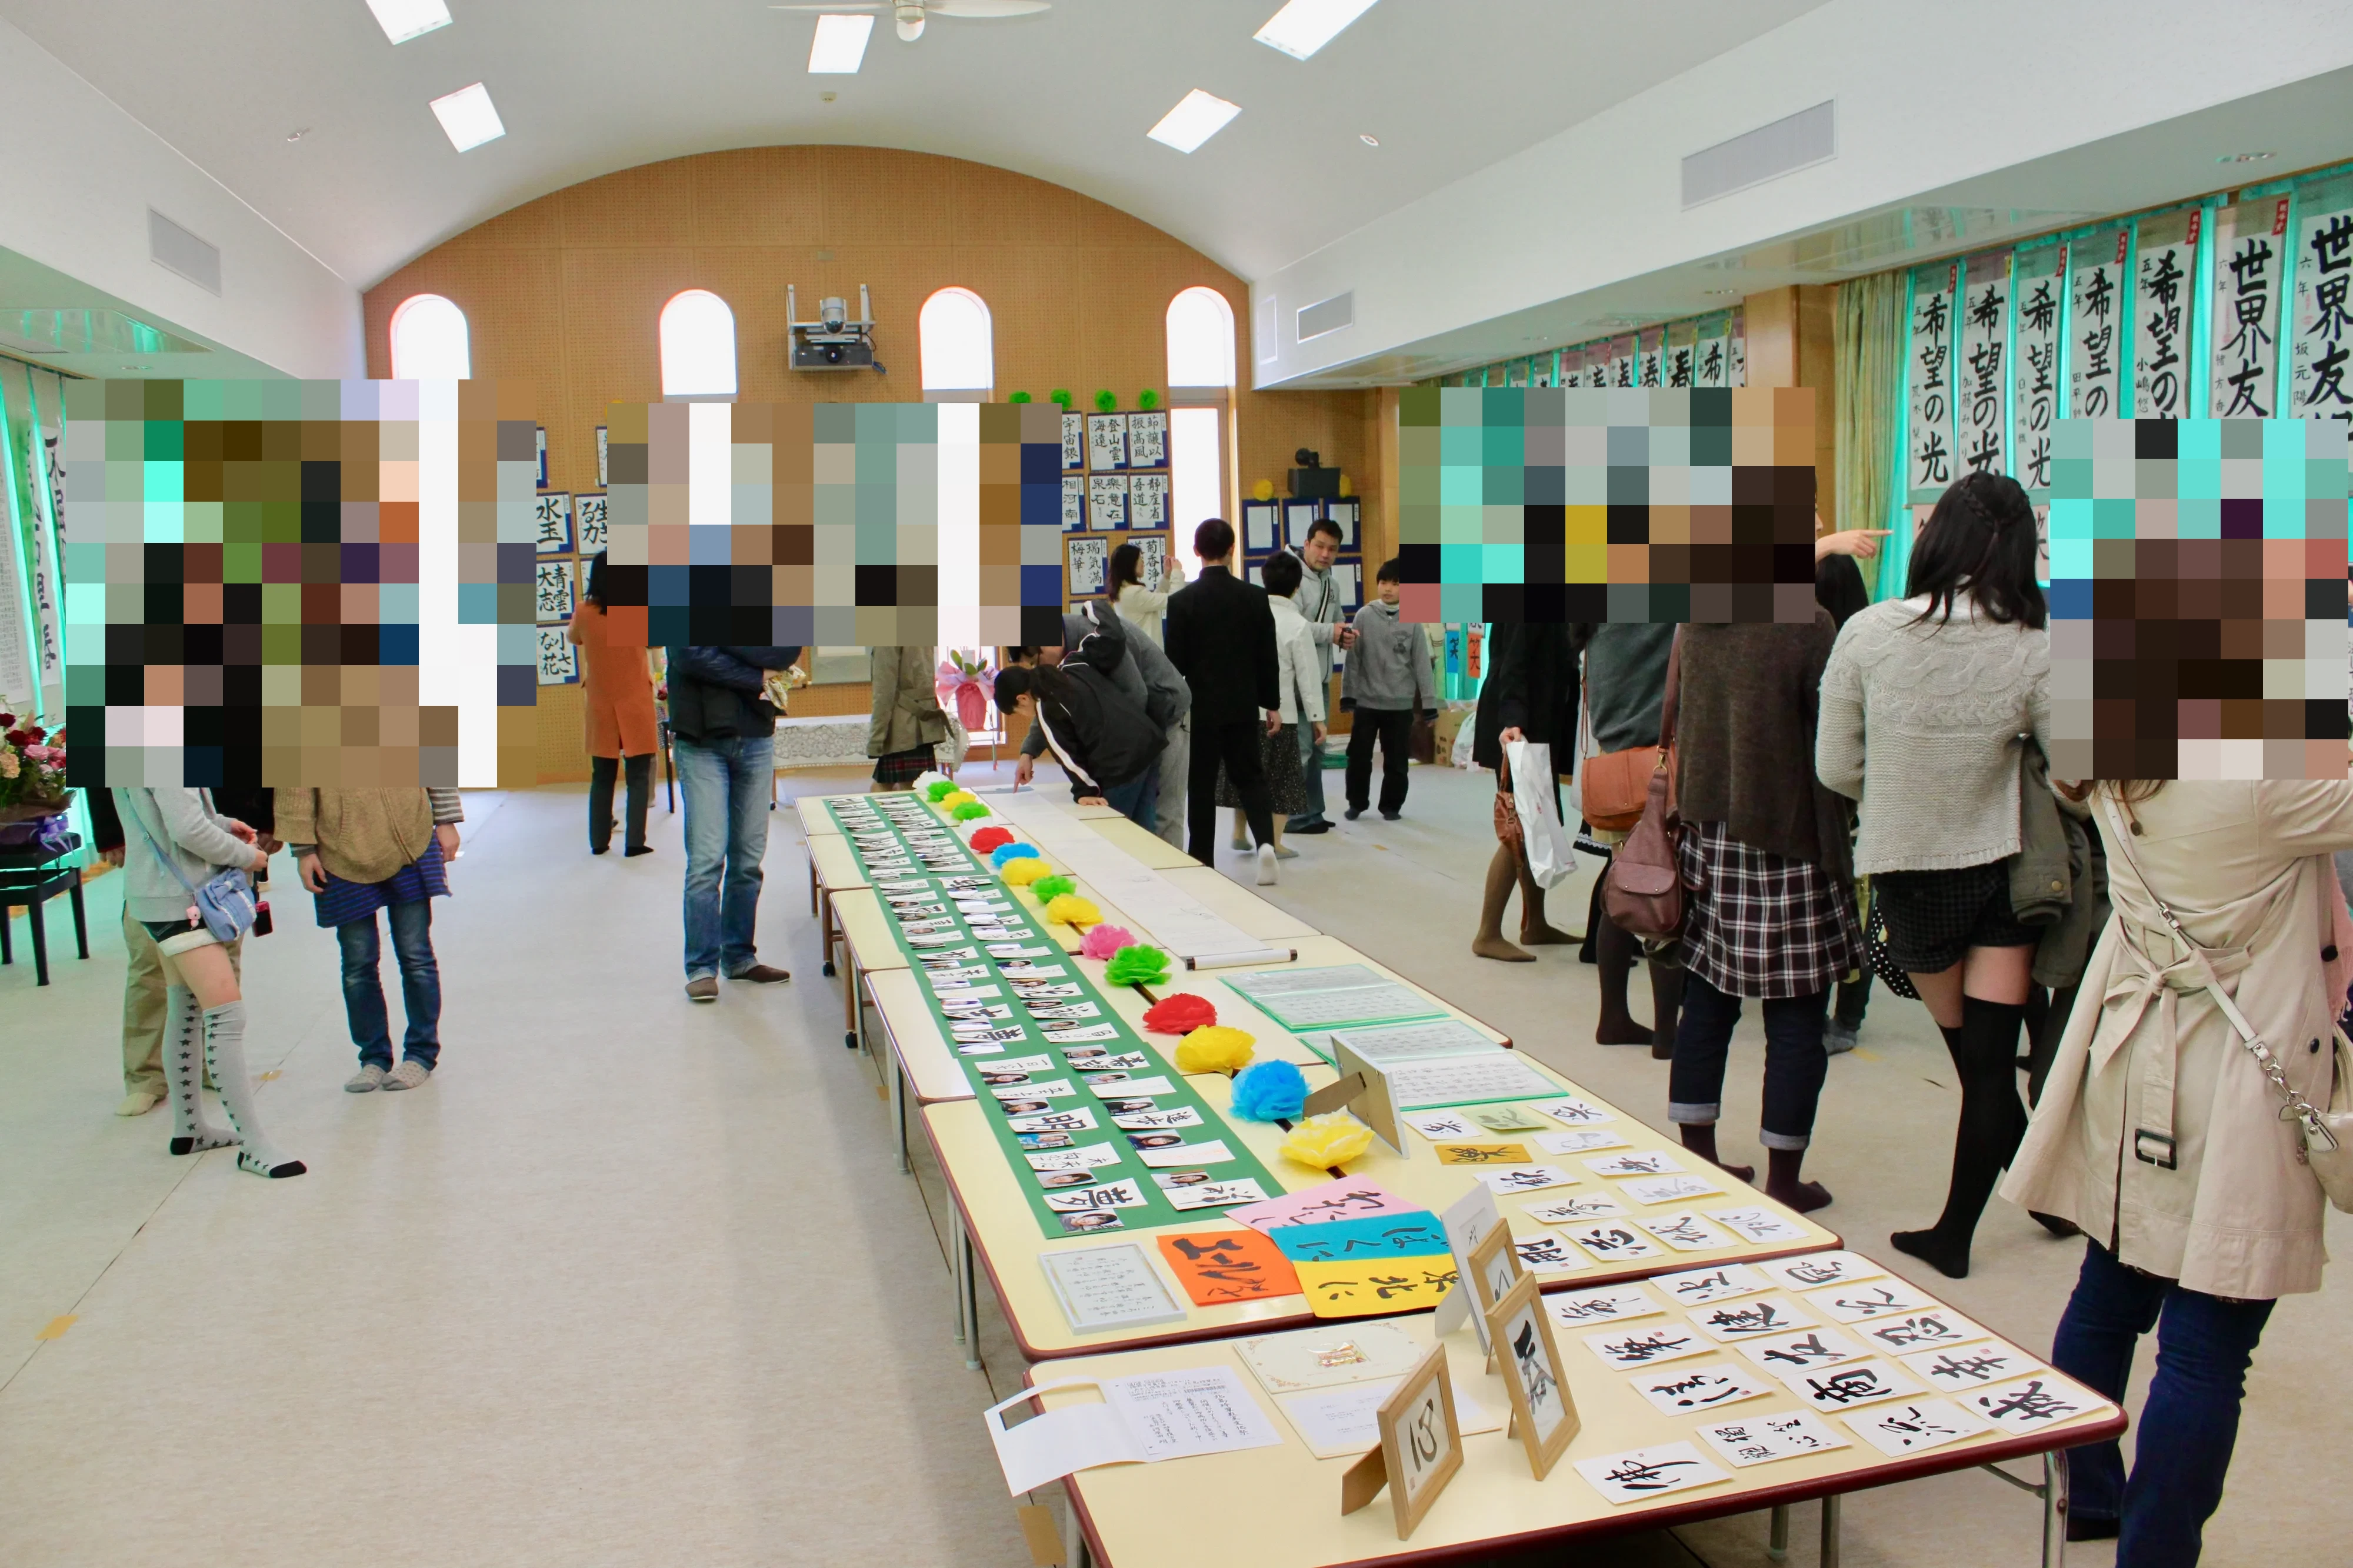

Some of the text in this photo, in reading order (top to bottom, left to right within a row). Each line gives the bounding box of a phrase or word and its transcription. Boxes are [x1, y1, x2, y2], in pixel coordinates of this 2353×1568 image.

[2073, 276, 2084, 310] 五年
[2140, 258, 2152, 293] 五年
[2218, 258, 2228, 293] 六年
[2298, 257, 2312, 296] 六年
[1912, 306, 1922, 339] 五年
[1965, 297, 1977, 329] 五年
[2018, 301, 2027, 335] 五年
[2220, 238, 2272, 417] 世界友
[2082, 268, 2114, 419] 希望の
[2147, 250, 2184, 419] 希望の
[1919, 293, 1948, 486] 希望の光
[1967, 283, 2005, 476] 希望の光
[2023, 280, 2056, 489] 希望の光
[2293, 342, 2311, 419] 坂元陽
[1063, 417, 1078, 460] 宇宙銀
[1094, 419, 1108, 448] 海遠
[1107, 418, 1121, 461] 登山雲
[1091, 478, 1106, 505] 泉石
[1133, 478, 1148, 506] 吾道
[536, 497, 564, 544] 水玉
[1071, 542, 1085, 572] 梅華
[537, 567, 555, 612] 大志
[552, 563, 569, 612] 青雲
[541, 632, 559, 676] な花
[554, 631, 571, 673] 小さ
[959, 1026, 1022, 1042] 夢
[1025, 1114, 1087, 1131] 明
[1121, 1111, 1193, 1126] 進歩
[1051, 1187, 1134, 1209] 夢
[1580, 1229, 1648, 1251] 志
[1785, 1262, 1844, 1284] 風
[1707, 1303, 1789, 1332] 健
[1873, 1317, 1962, 1346] 忍
[1604, 1336, 1692, 1361] 筆
[1764, 1333, 1847, 1365] 友
[1931, 1355, 2010, 1380] 幸
[1806, 1369, 1892, 1404] 商
[1978, 1380, 2078, 1421] 城
[1878, 1406, 1957, 1446] 流
